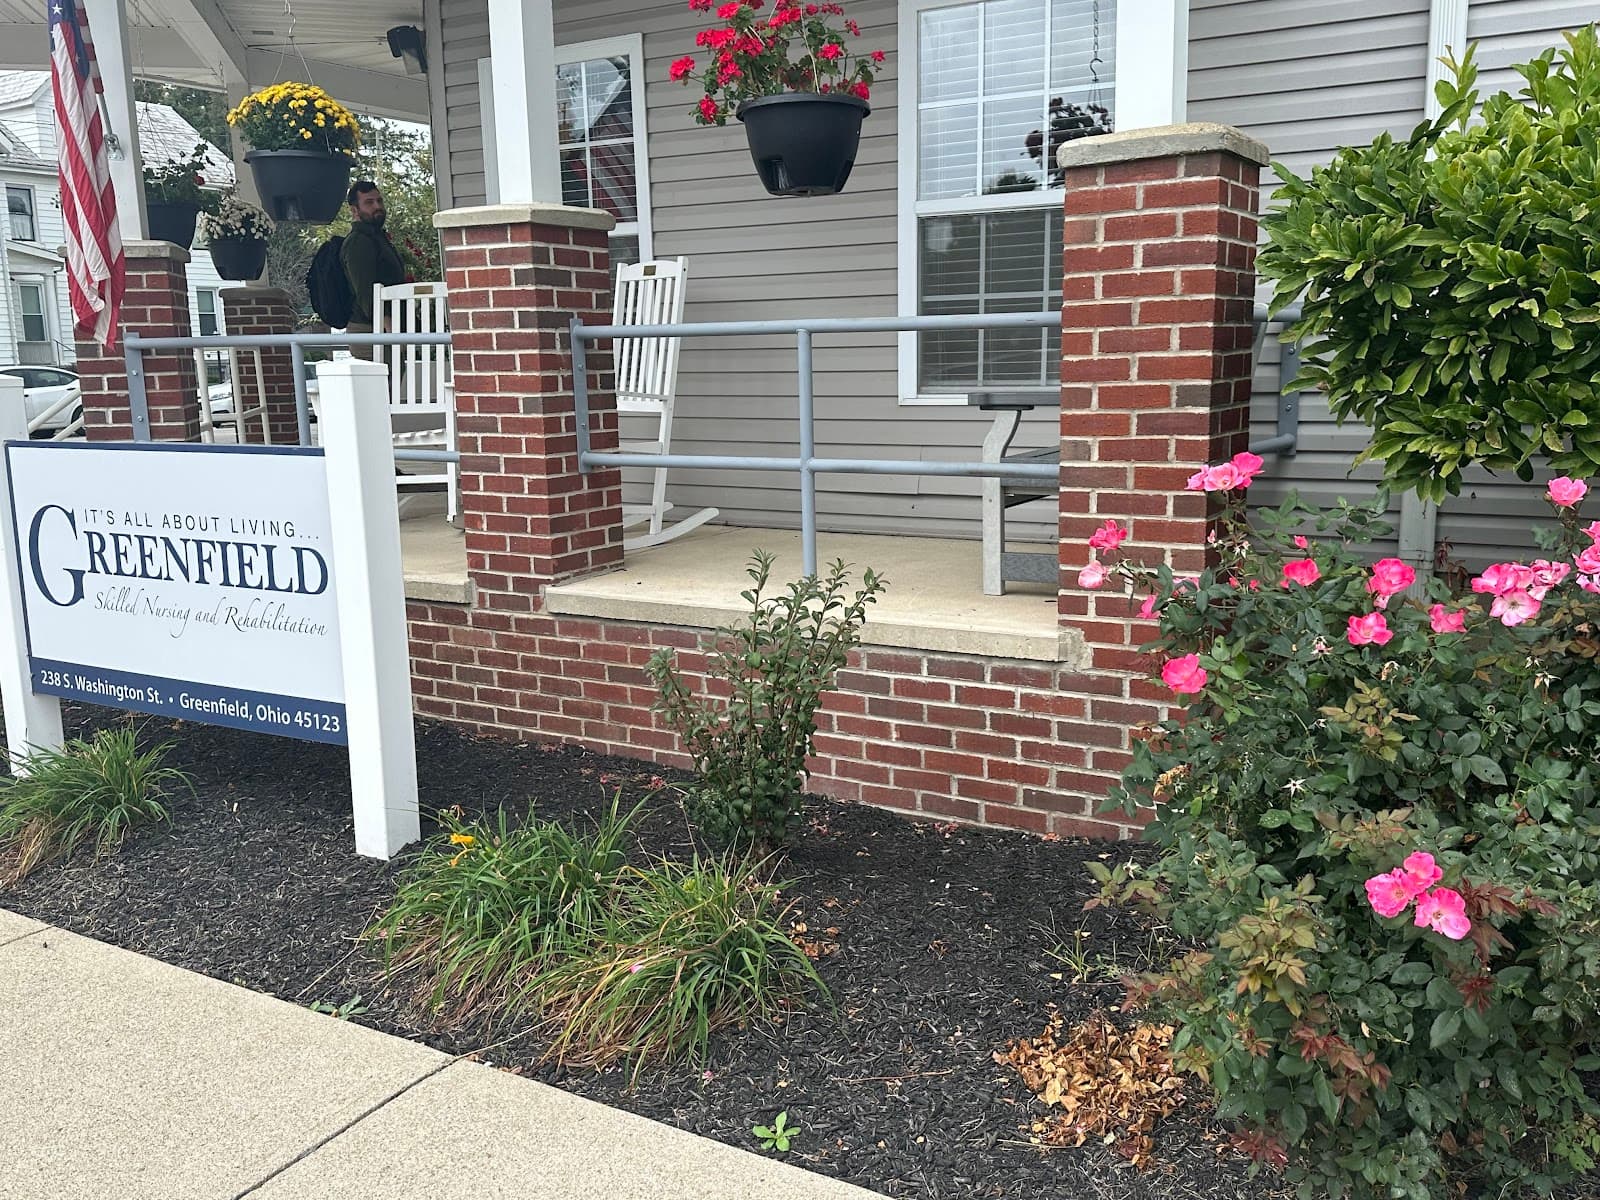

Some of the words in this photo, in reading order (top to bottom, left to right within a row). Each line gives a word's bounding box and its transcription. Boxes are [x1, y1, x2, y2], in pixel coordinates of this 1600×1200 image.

[84, 508, 116, 525] IT'S
[124, 512, 153, 528] ALL
[162, 514, 220, 533] ABOUT
[28, 504, 329, 607] GREENFIELD
[94, 586, 144, 616] Skilled
[143, 596, 190, 638] Nursing
[195, 597, 226, 626] and
[224, 597, 328, 636] Rehabilitation
[41, 669, 62, 687] 238
[63, 673, 74, 689] S.
[75, 675, 144, 704] Washington
[147, 687, 164, 705] St.
[179, 693, 253, 721] Greenfield,
[256, 705, 291, 725] Ohio
[294, 711, 341, 732] 45123
